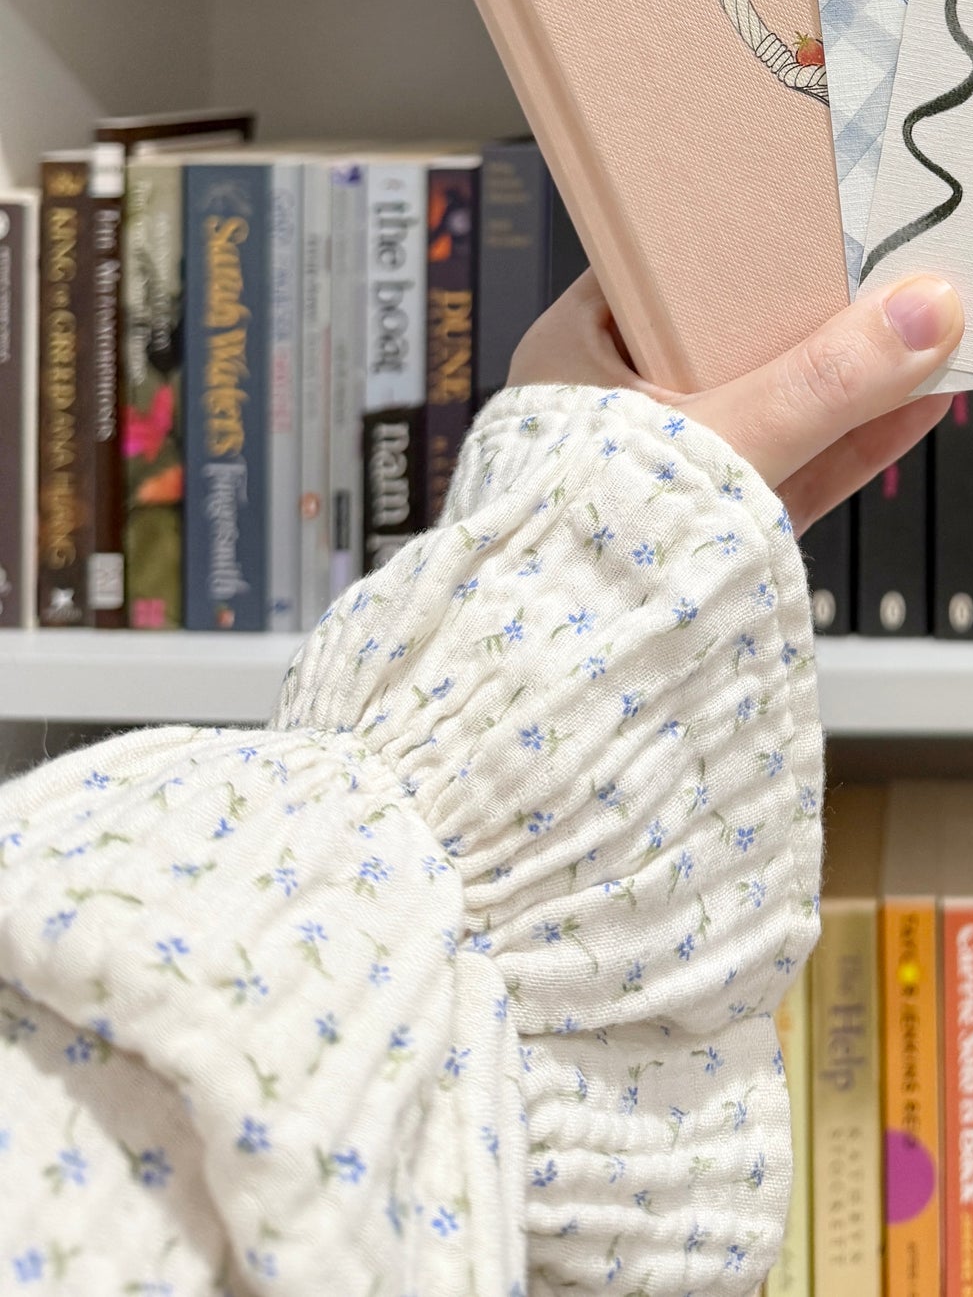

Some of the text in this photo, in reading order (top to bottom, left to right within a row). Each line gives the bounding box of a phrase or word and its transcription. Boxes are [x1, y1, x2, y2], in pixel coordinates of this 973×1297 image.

[203, 214, 250, 328] Sarah
[371, 201, 421, 375] the boat
[202, 328, 249, 458] Waters
[440, 289, 473, 404] DUNE
[370, 422, 414, 527] nam
[820, 1003, 866, 1093] Help
